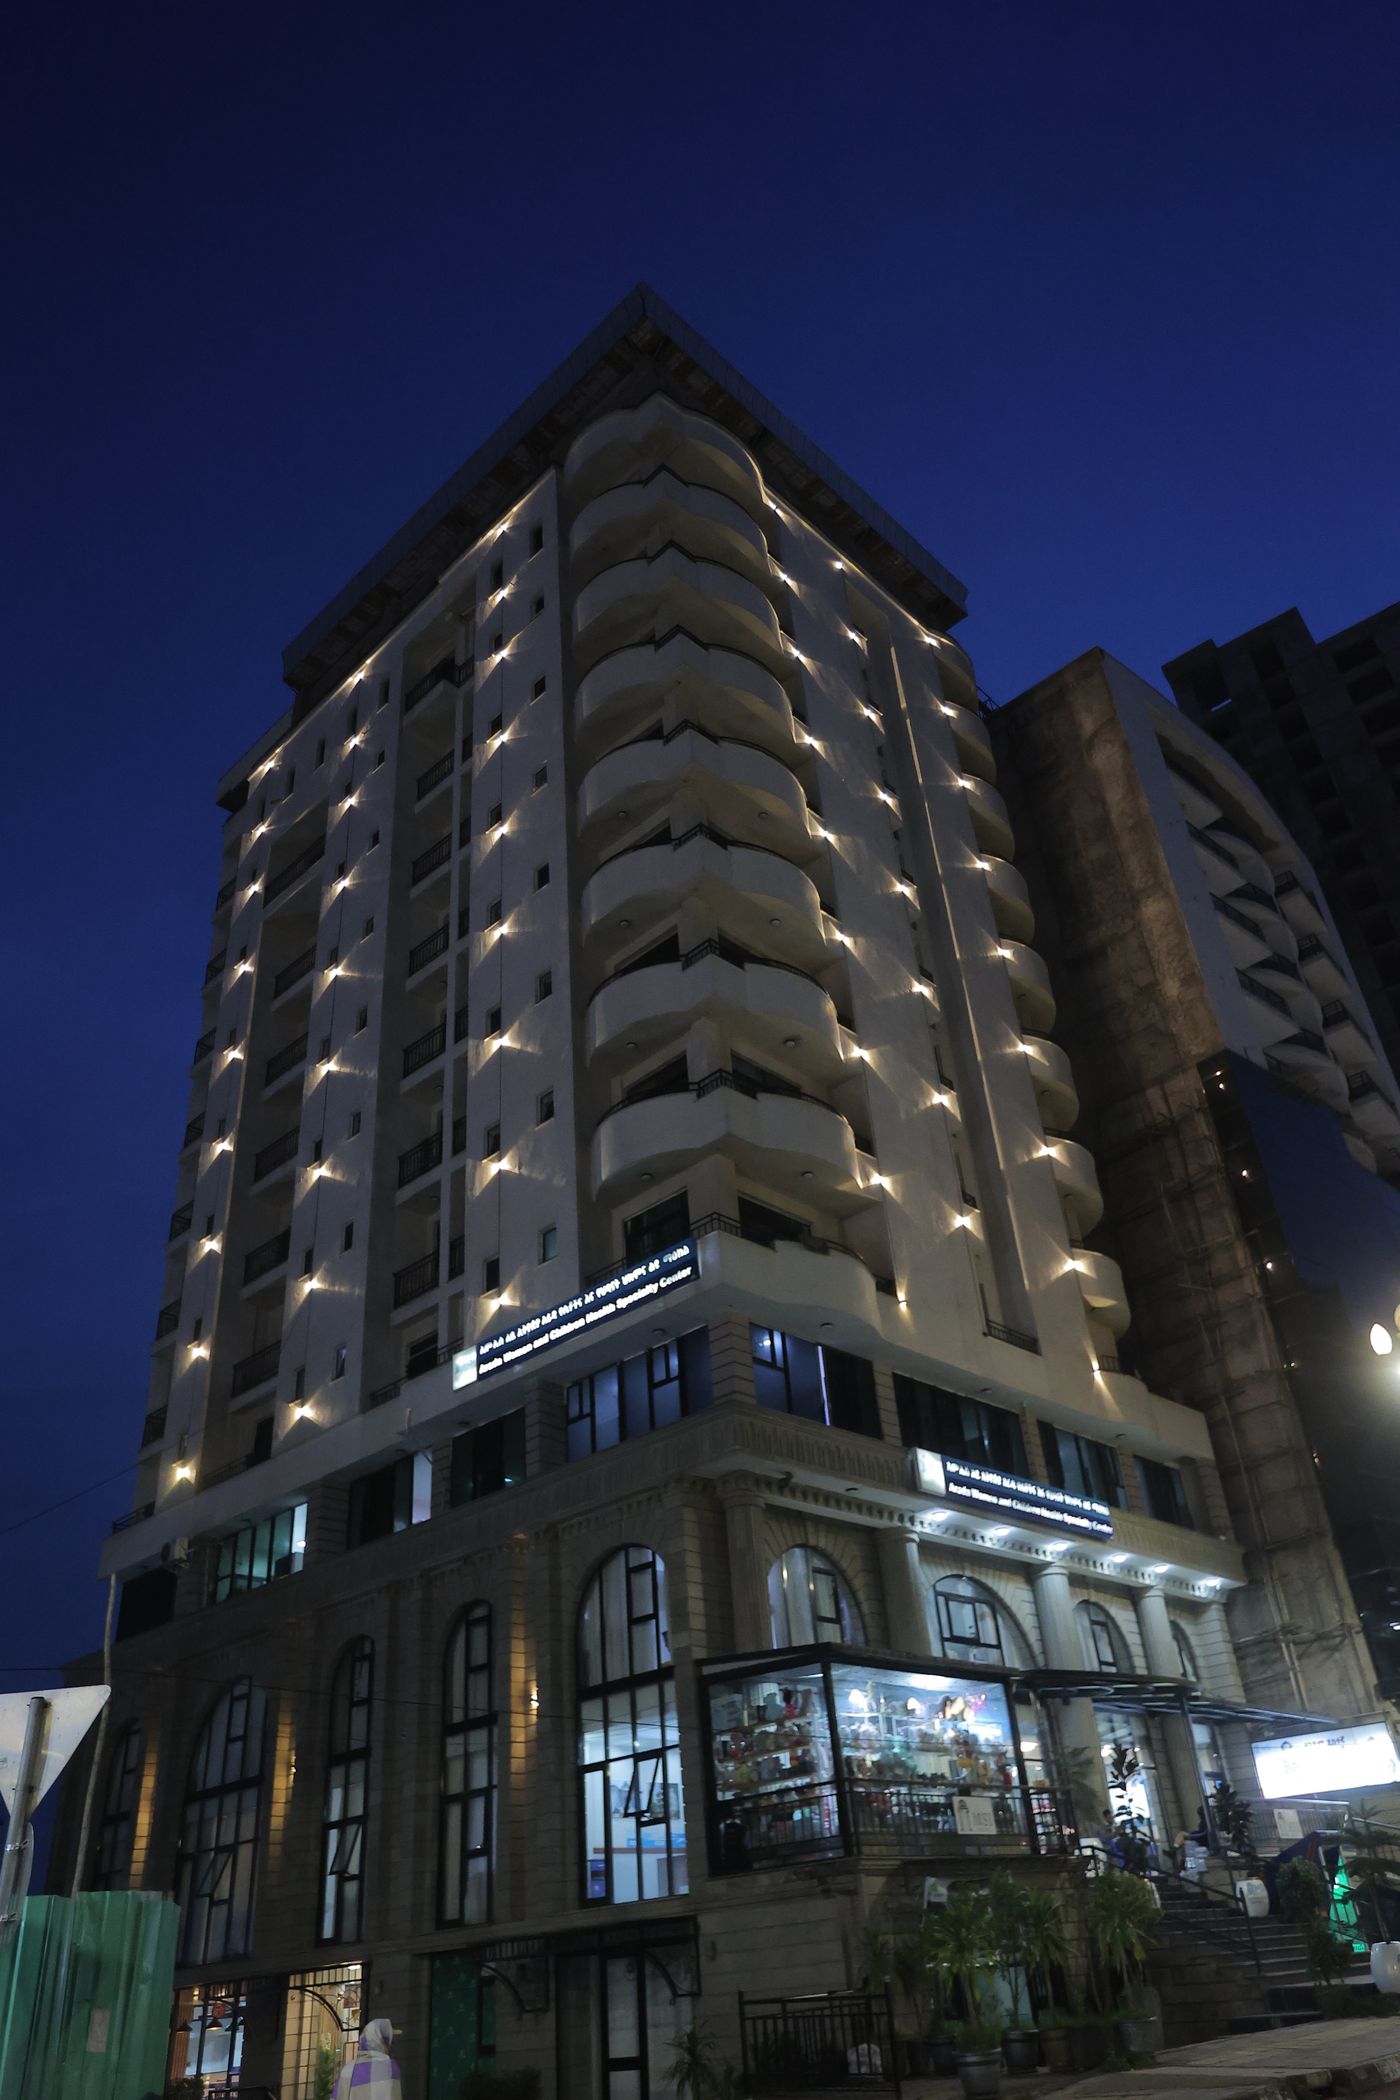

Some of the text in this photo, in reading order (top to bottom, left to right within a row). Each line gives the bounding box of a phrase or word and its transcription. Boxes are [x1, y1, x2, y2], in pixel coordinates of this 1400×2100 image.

[502, 1342, 533, 1363] Women
[532, 1333, 549, 1349] and
[549, 1317, 585, 1340] Children
[585, 1302, 616, 1324] Health
[615, 1282, 659, 1309] Specialty
[659, 1266, 692, 1288] Center
[970, 1487, 998, 1504] Women
[997, 1497, 1012, 1507] and
[1011, 1499, 1041, 1515] Children
[1039, 1506, 1064, 1521] Health
[1062, 1512, 1093, 1530] Specialty
[1092, 1521, 1113, 1534] Center
